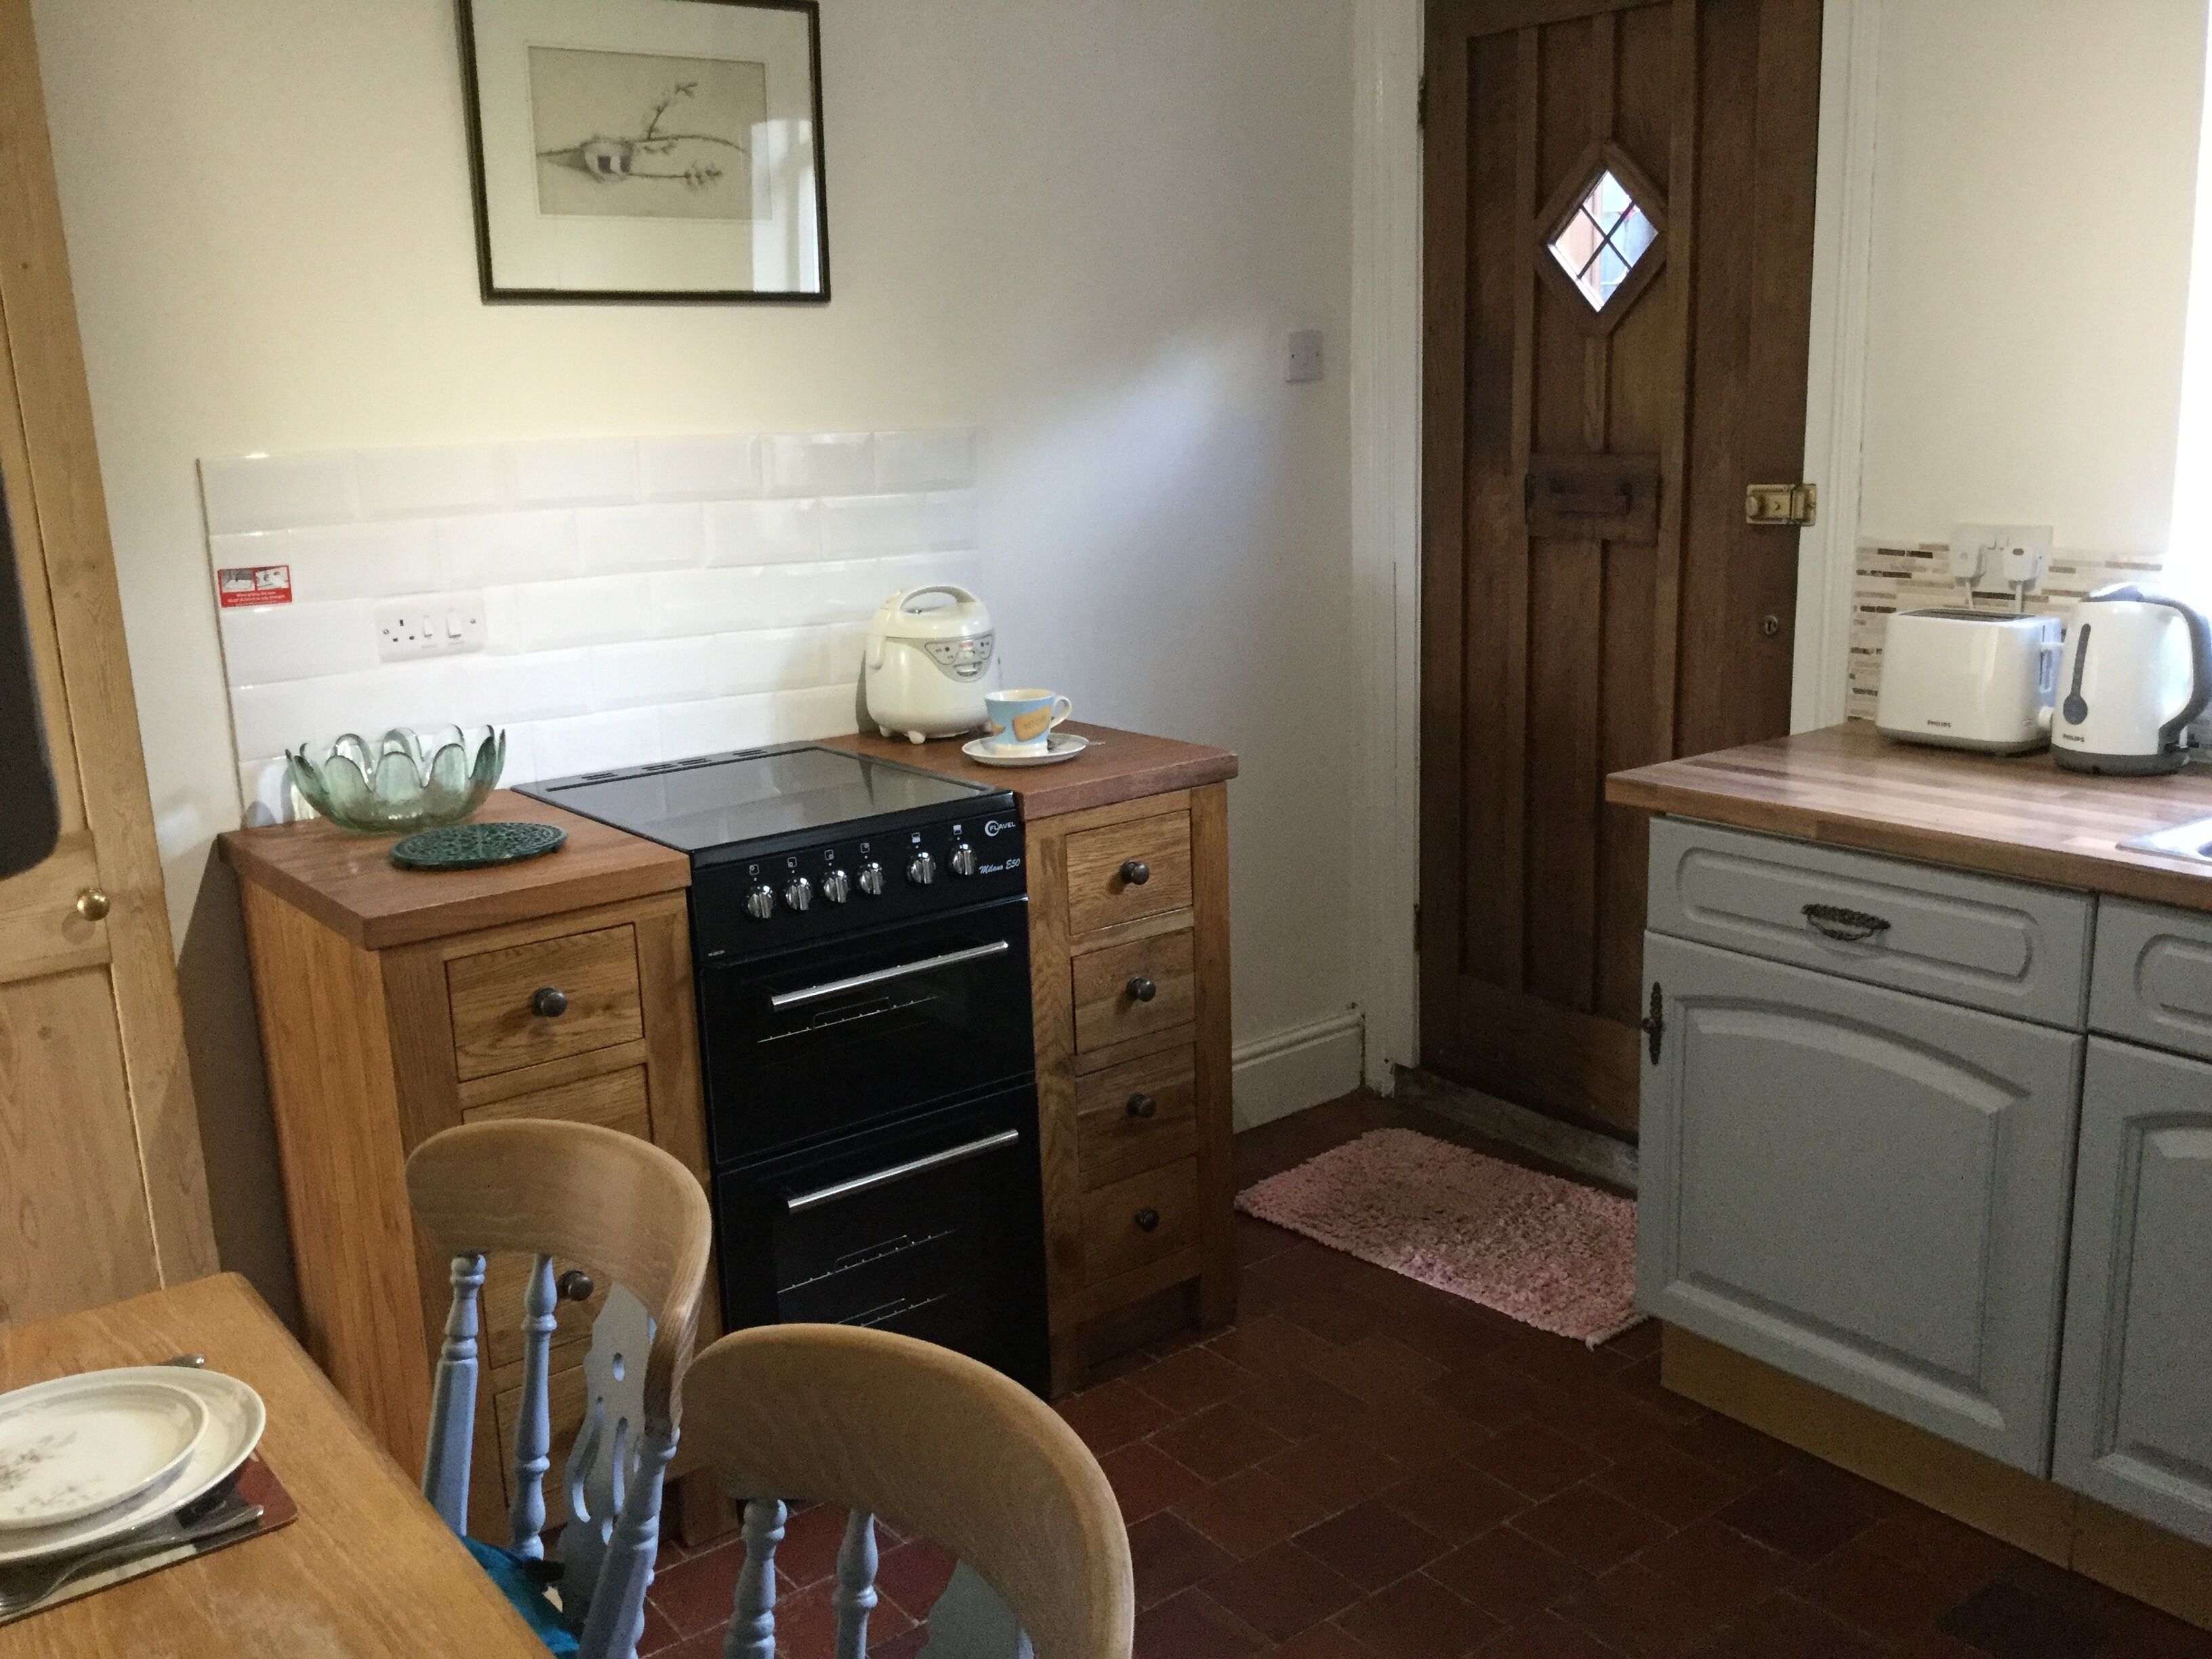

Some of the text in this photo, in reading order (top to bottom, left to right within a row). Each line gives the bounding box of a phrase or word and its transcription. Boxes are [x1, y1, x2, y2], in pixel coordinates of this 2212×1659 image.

[1927, 720, 1952, 728] PHILIPS
[2062, 733, 2085, 742] PHILIPS
[989, 821, 1016, 832] FLAVEL
[979, 864, 1004, 874] Milano
